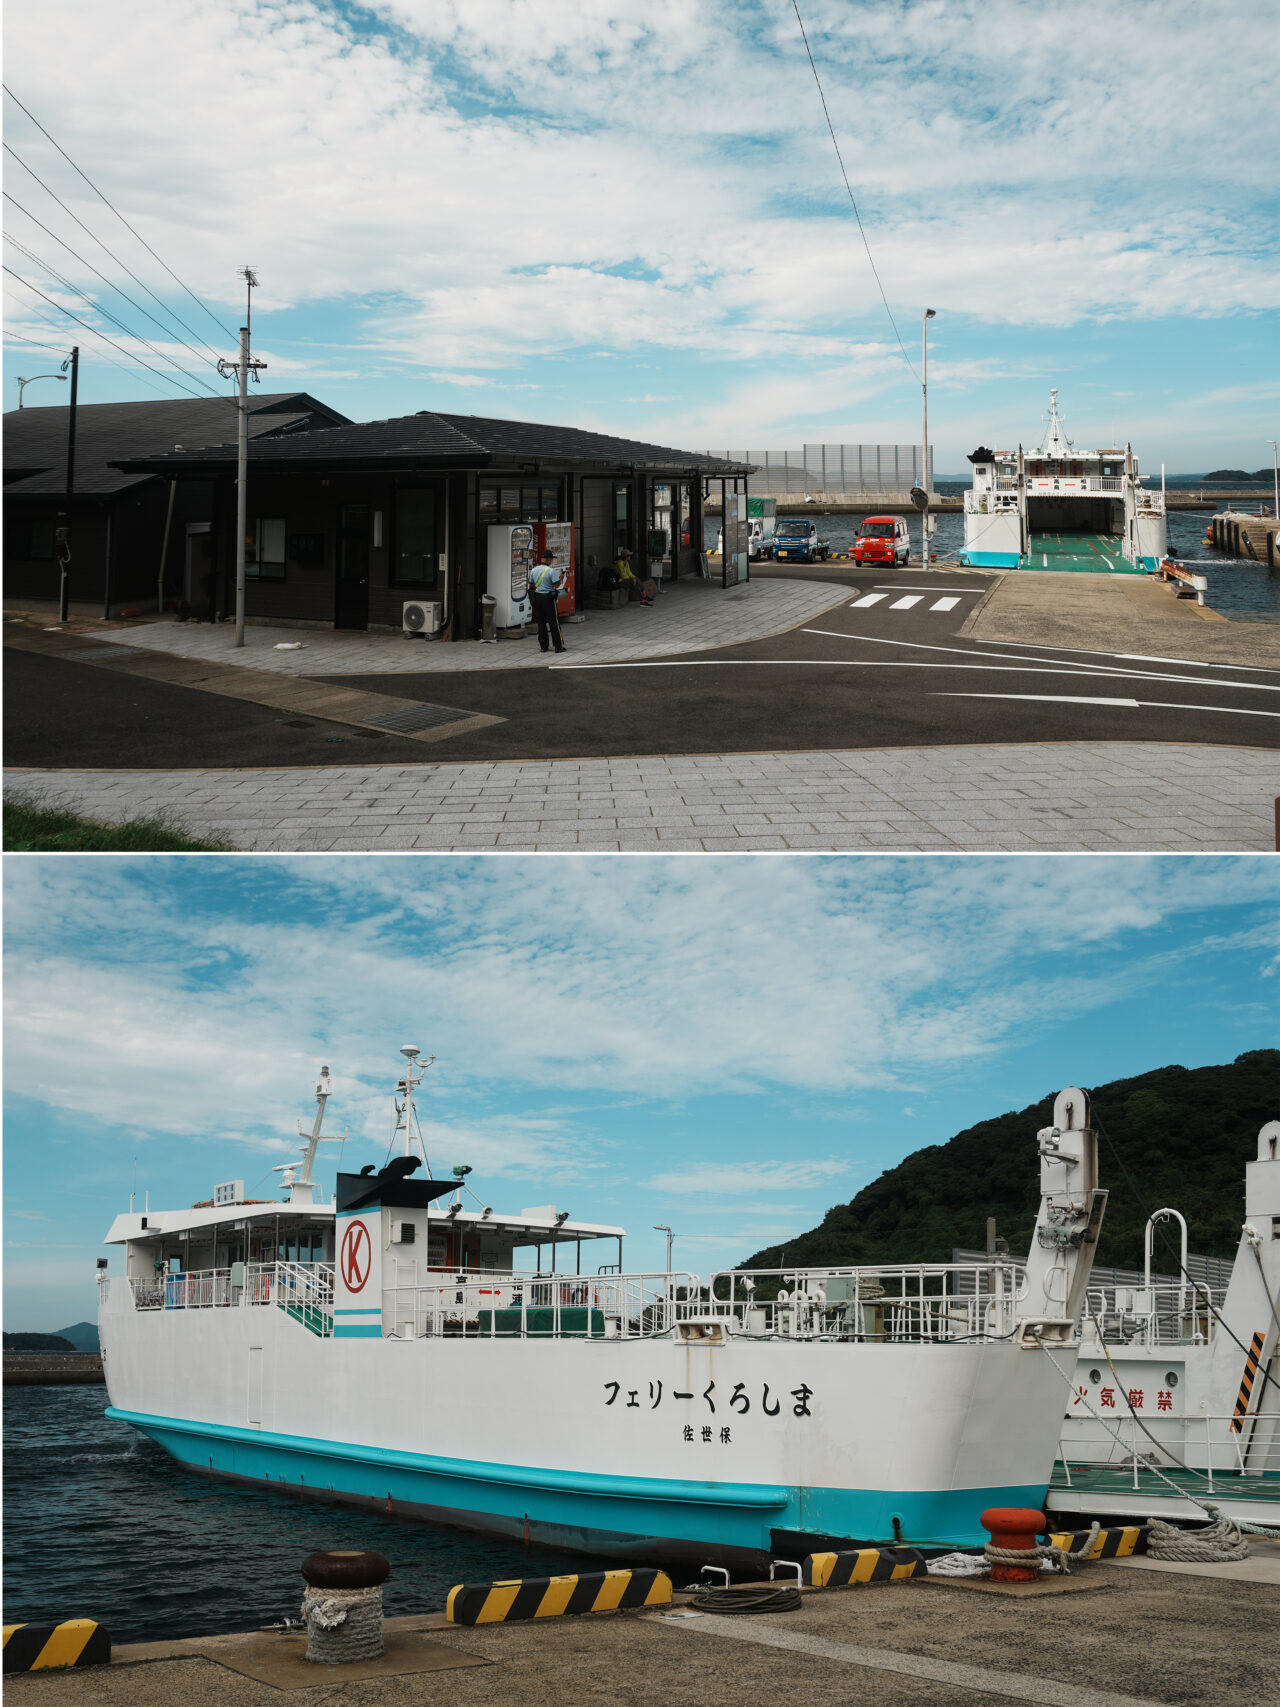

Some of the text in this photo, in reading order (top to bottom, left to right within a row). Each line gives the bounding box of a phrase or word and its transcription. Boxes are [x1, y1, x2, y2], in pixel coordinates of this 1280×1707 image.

[604, 1379, 814, 1417] フェリーくろしま
[683, 1424, 732, 1444] 佐世保
